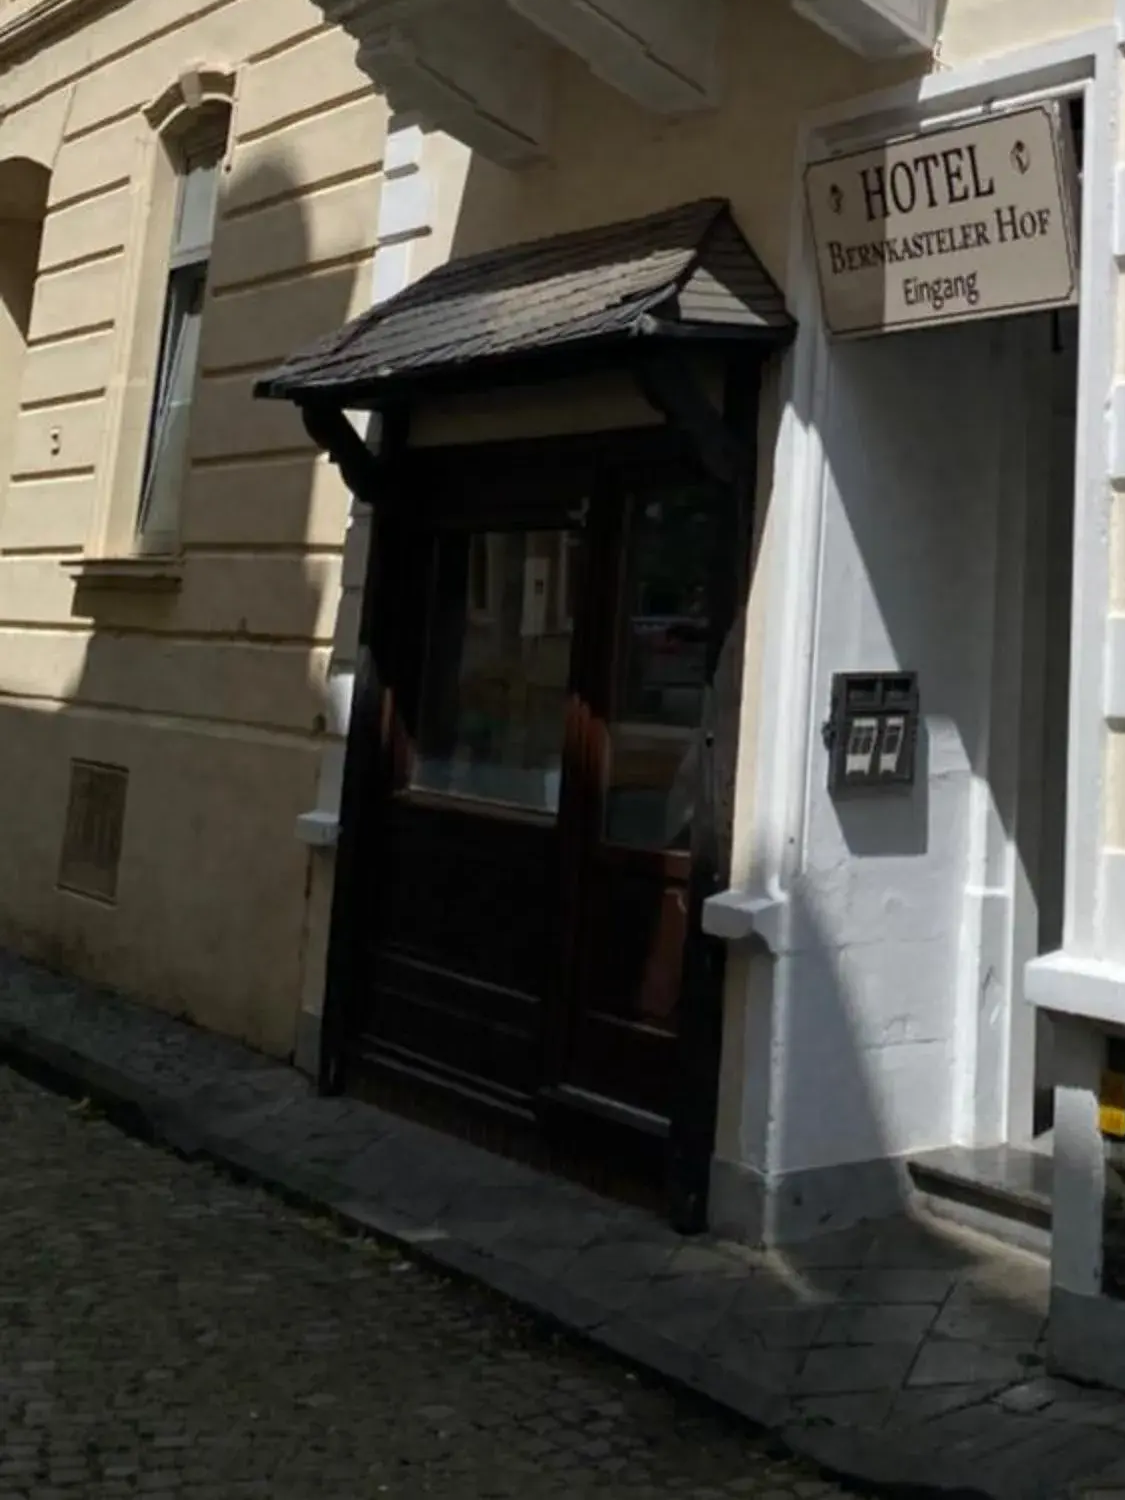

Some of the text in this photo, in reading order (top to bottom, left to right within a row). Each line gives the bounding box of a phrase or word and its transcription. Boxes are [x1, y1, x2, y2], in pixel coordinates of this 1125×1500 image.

[859, 144, 995, 222] HOTEL
[827, 204, 1051, 274] BERNKASTELER HOF
[903, 271, 979, 310] Eingang
